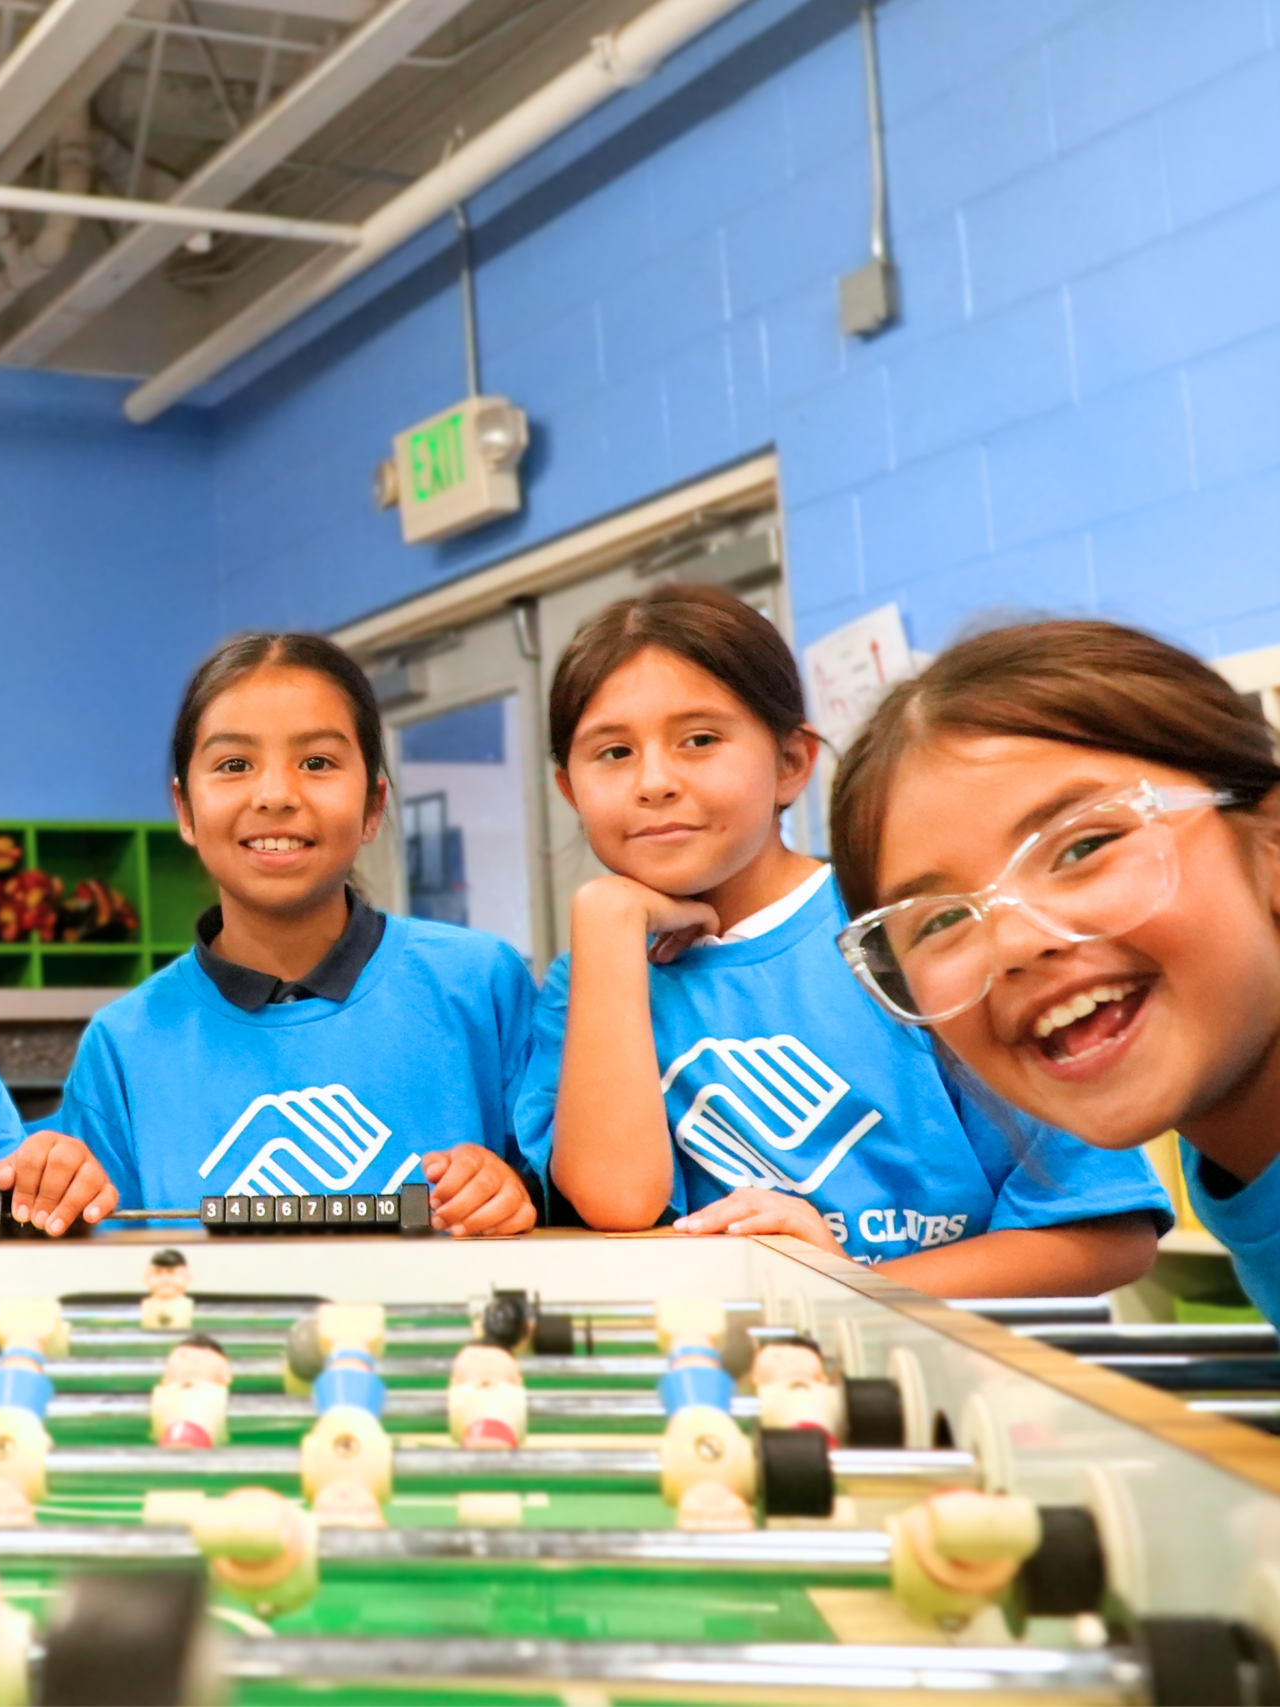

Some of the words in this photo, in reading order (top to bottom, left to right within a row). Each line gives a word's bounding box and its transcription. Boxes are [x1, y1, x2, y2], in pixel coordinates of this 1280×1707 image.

[410, 413, 464, 503] EXIT
[206, 1202, 217, 1217] 3
[230, 1202, 241, 1216] 4
[255, 1202, 266, 1216] 5
[281, 1202, 292, 1216] 6
[307, 1201, 317, 1216] 7
[332, 1201, 343, 1216] 8
[357, 1201, 368, 1216] 9
[378, 1200, 395, 1215] 10
[858, 1208, 968, 1247] CLUBS
